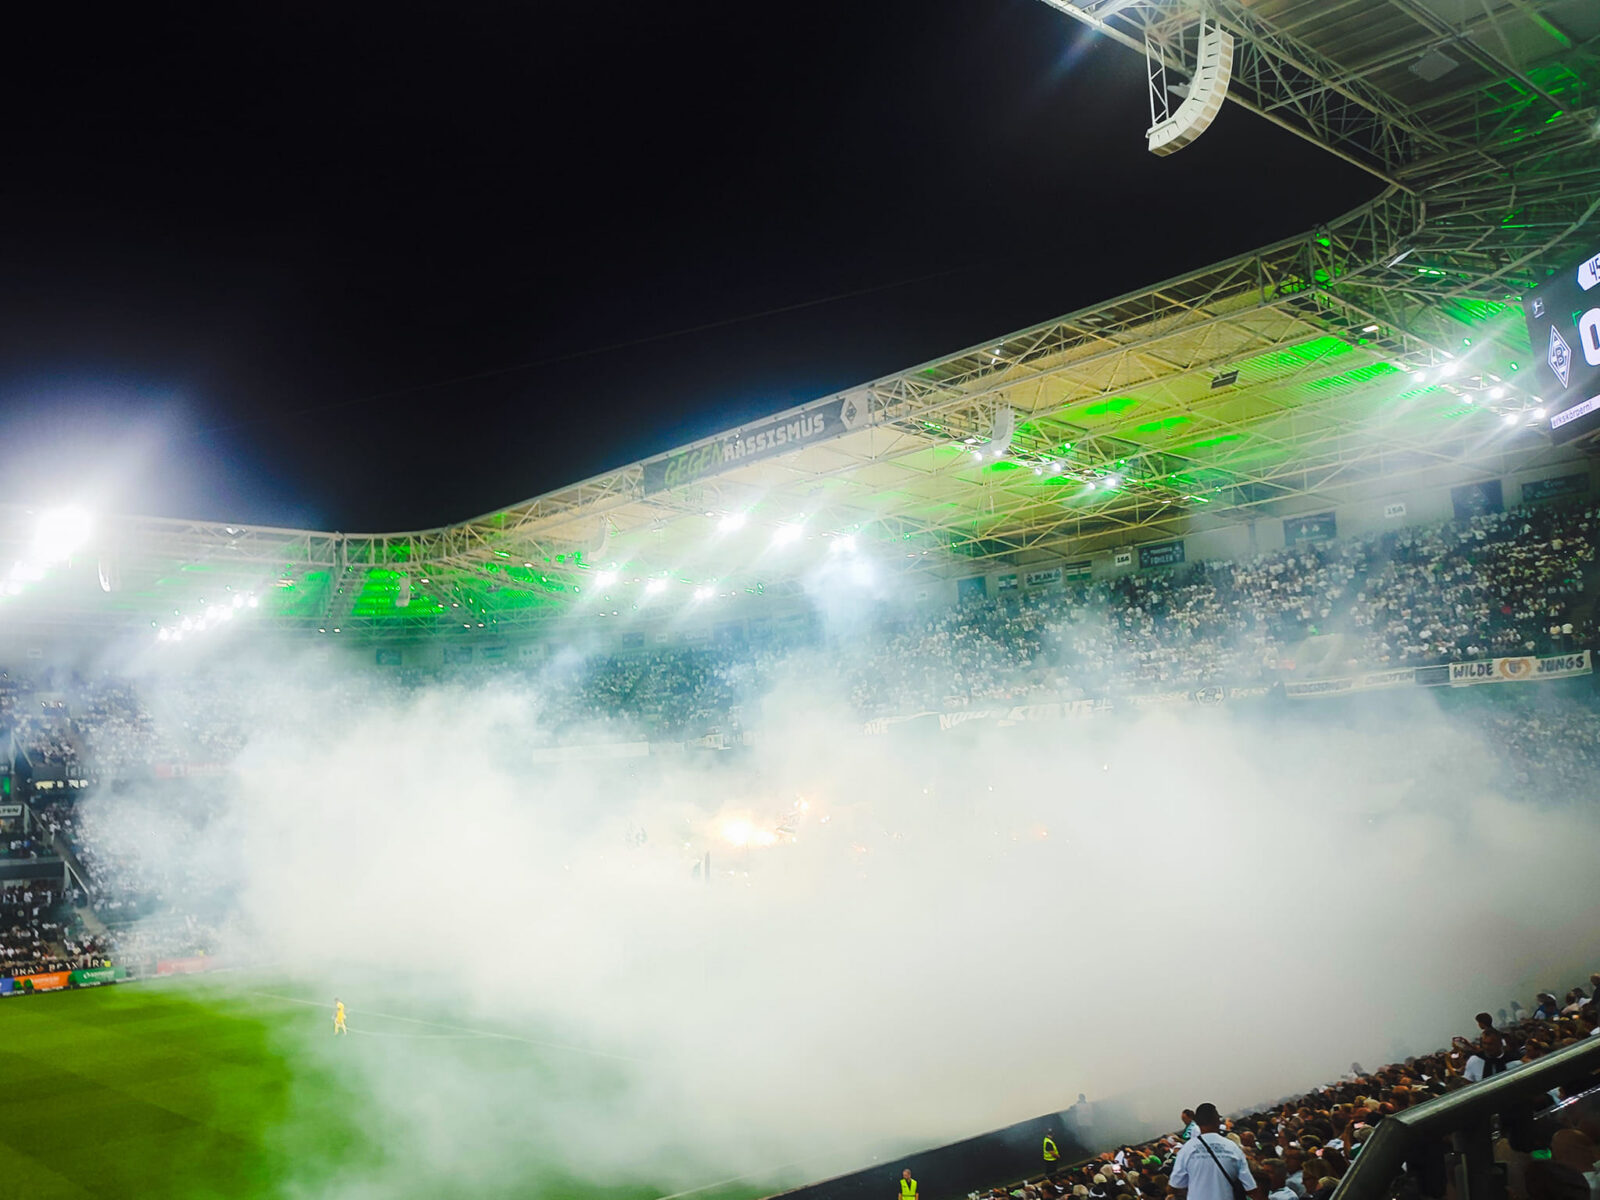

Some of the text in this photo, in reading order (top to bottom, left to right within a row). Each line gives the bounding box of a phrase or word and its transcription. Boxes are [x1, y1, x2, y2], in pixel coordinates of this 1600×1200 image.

[664, 442, 723, 486] GEGEN
[1453, 656, 1585, 680] WILDE JUNGS
